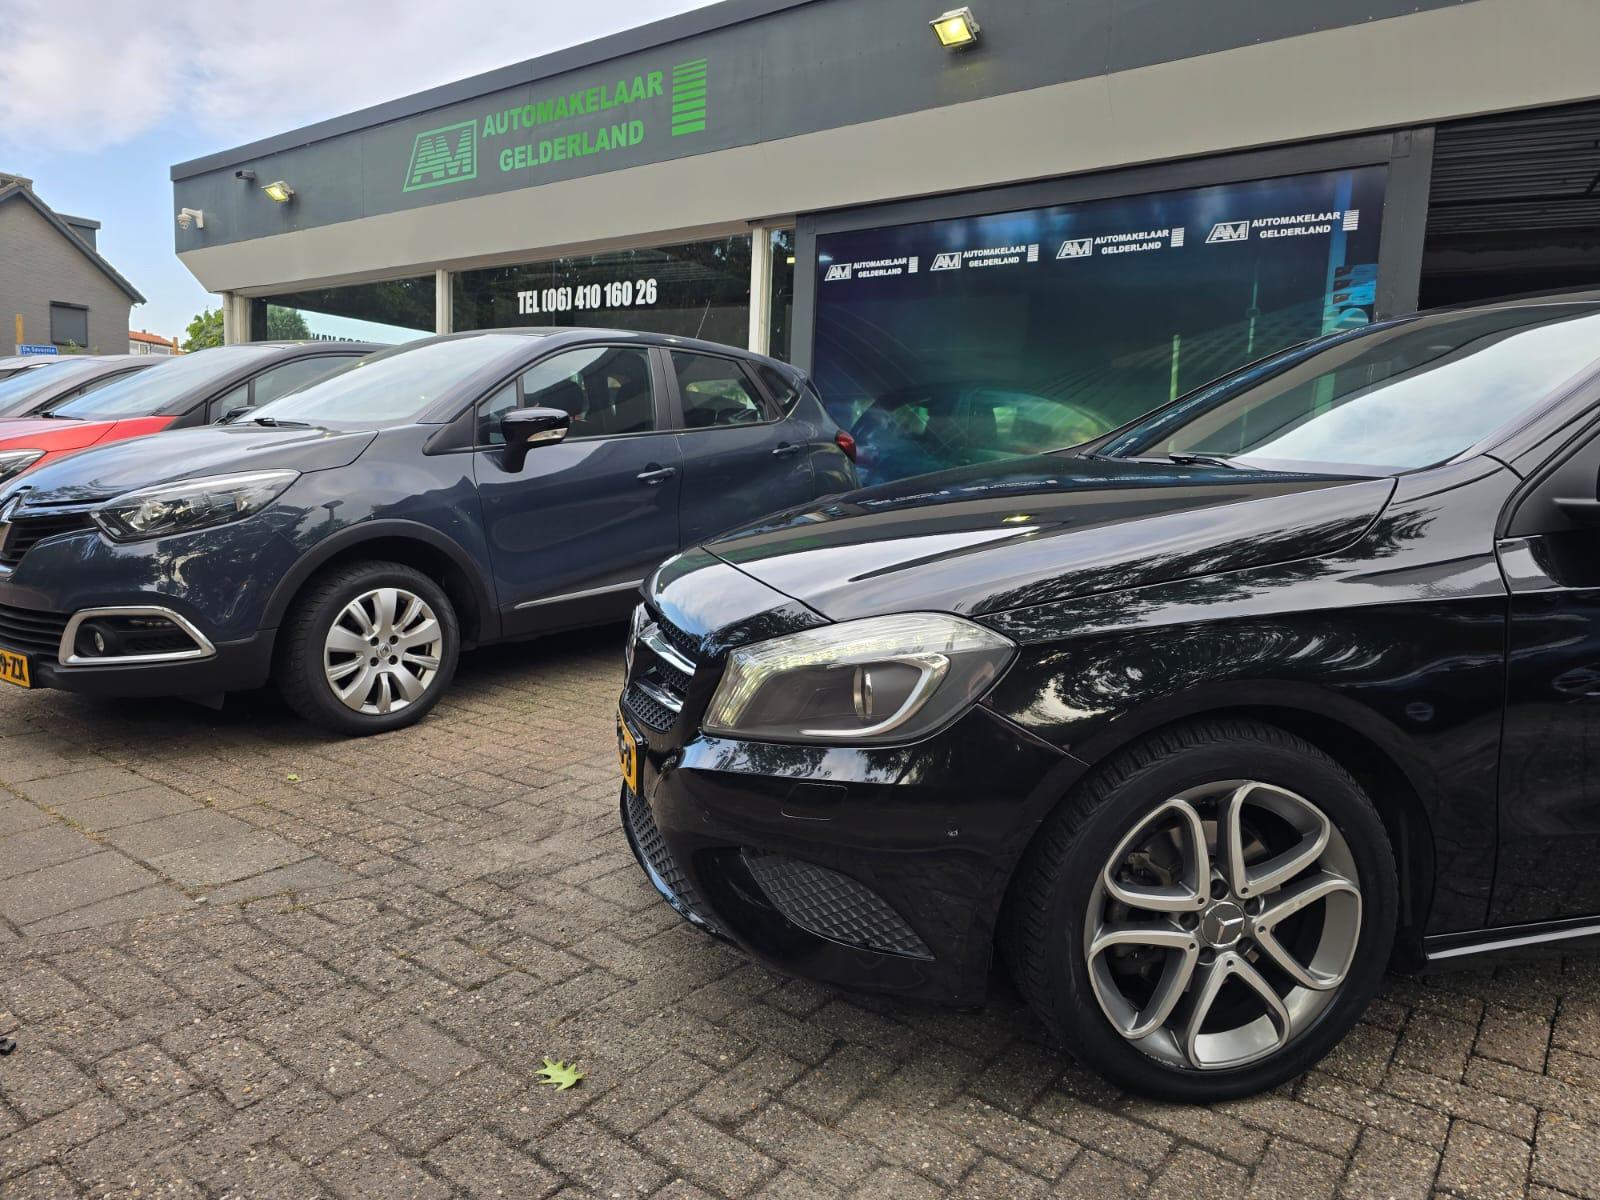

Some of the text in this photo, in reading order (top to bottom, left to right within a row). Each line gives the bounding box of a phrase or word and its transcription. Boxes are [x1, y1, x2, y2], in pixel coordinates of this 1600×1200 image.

[482, 71, 663, 138] AUTOMAKELAAR
[499, 119, 645, 172] GELDERLAND
[410, 127, 473, 184] AM
[1252, 211, 1341, 228] AUTOMAKELAAR
[1094, 229, 1169, 244] AUTOMAKELAAR
[1208, 222, 1248, 242] AM
[1259, 224, 1331, 239] GELDERLAND
[962, 245, 1026, 259] AUTOMAKELAAR
[1059, 239, 1092, 258] AM
[1101, 241, 1161, 255] GELDERLAND
[852, 257, 907, 270] AUTOMAKELAAR
[931, 253, 961, 270] AM
[968, 256, 1020, 268] GELDERLAND
[826, 264, 851, 280] AM
[857, 267, 902, 279] GELDERLAND
[517, 278, 657, 314] TEL (06) 410 160 26
